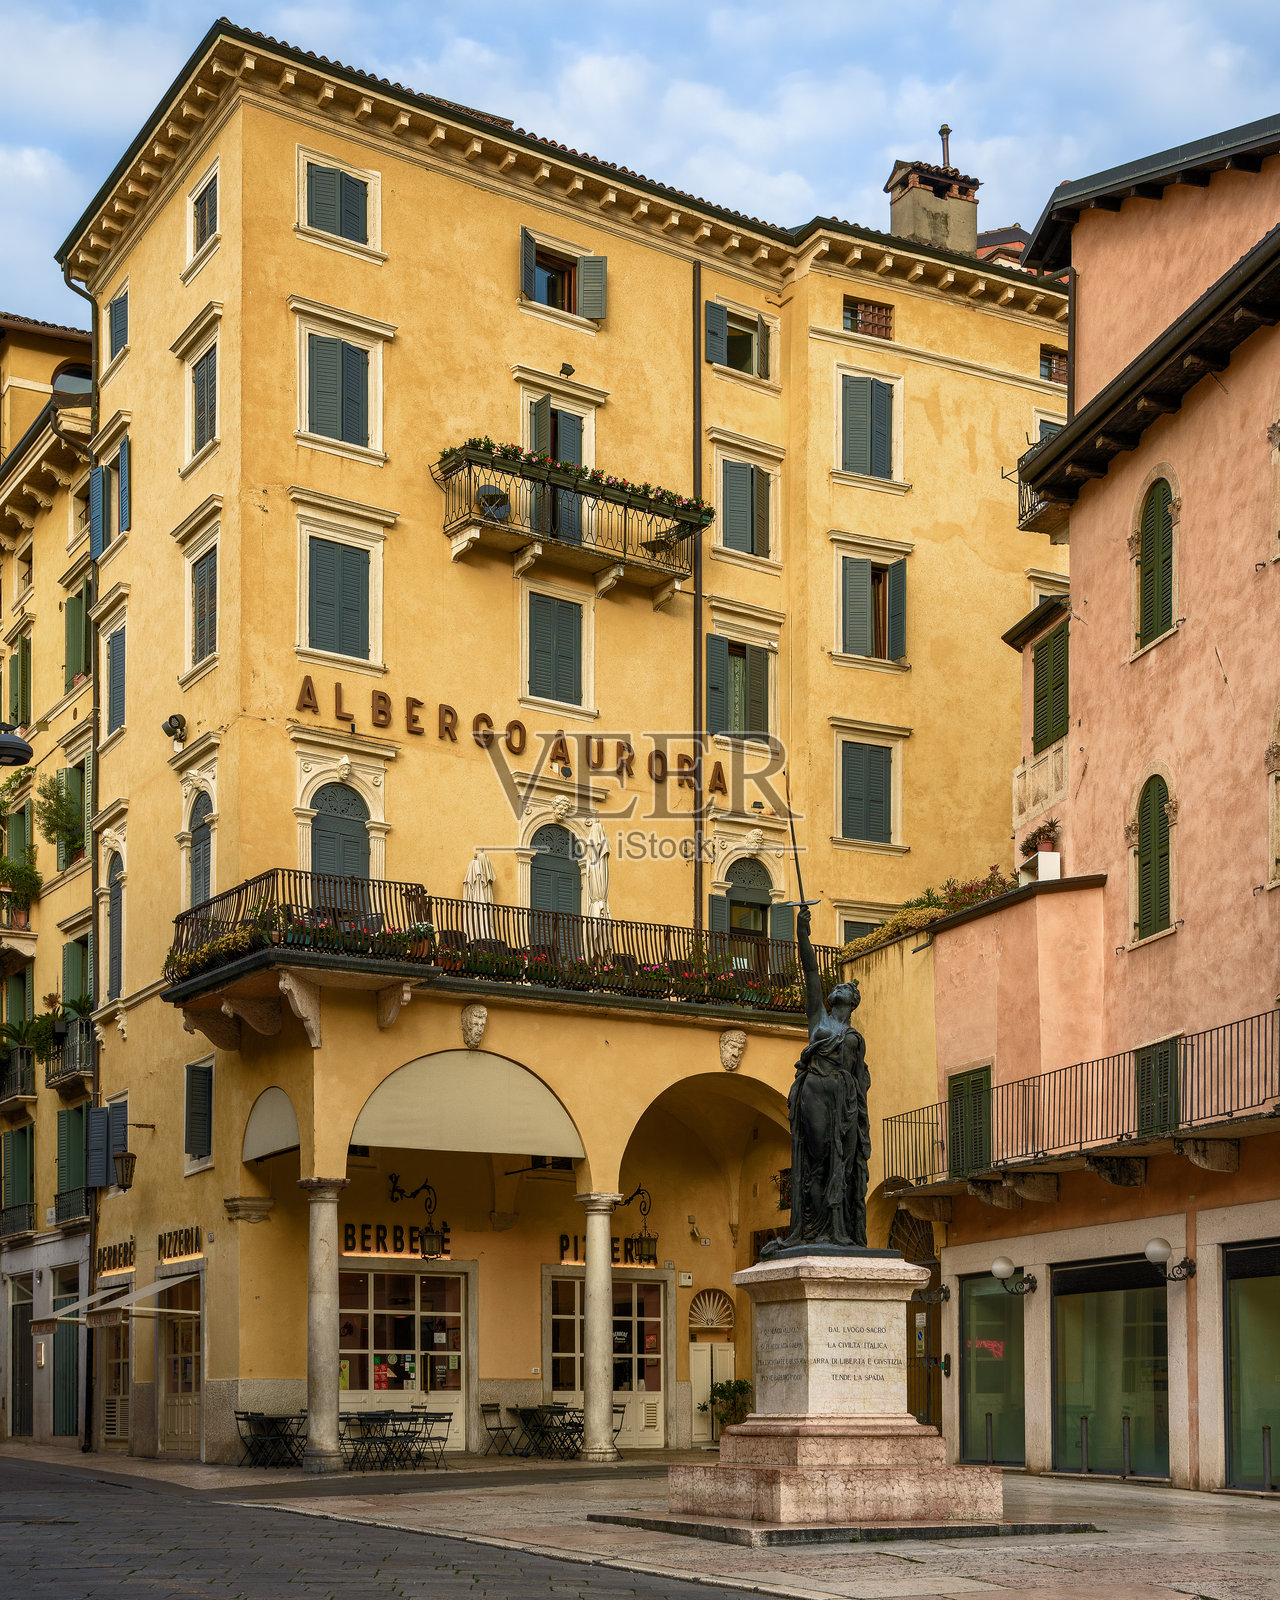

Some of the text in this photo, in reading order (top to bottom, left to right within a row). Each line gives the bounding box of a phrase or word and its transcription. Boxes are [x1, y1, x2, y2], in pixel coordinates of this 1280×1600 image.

[296, 675, 727, 795] ALBERGO AURORA
[344, 1221, 451, 1255] BERBEÈ
[158, 1225, 201, 1260] PIZZERIA
[843, 1326, 865, 1334] LVOGO
[864, 1341, 888, 1349] ITALICA
[874, 1358, 903, 1366] GIVSTIZIA
[864, 1374, 885, 1382] SPADA
